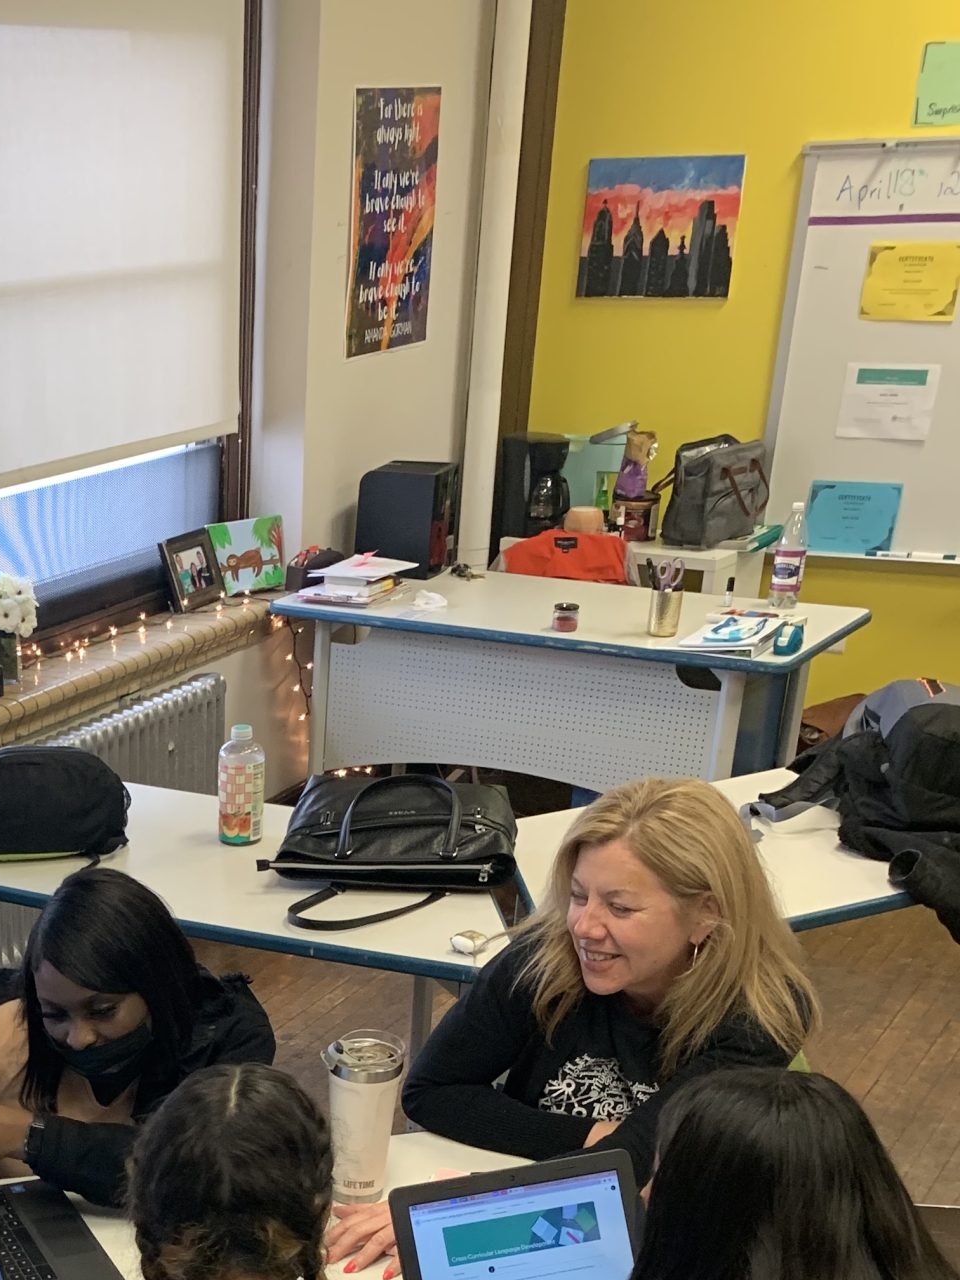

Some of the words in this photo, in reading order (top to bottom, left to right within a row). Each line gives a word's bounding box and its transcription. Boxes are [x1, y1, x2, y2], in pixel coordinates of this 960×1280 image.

[376, 124, 402, 150] always
[382, 170, 398, 197] only
[836, 171, 893, 210] April
[365, 193, 390, 214] brave
[390, 189, 417, 214] enough
[383, 217, 397, 232] see
[358, 284, 384, 304] brave
[411, 275, 420, 296] to
[378, 302, 388, 321] be
